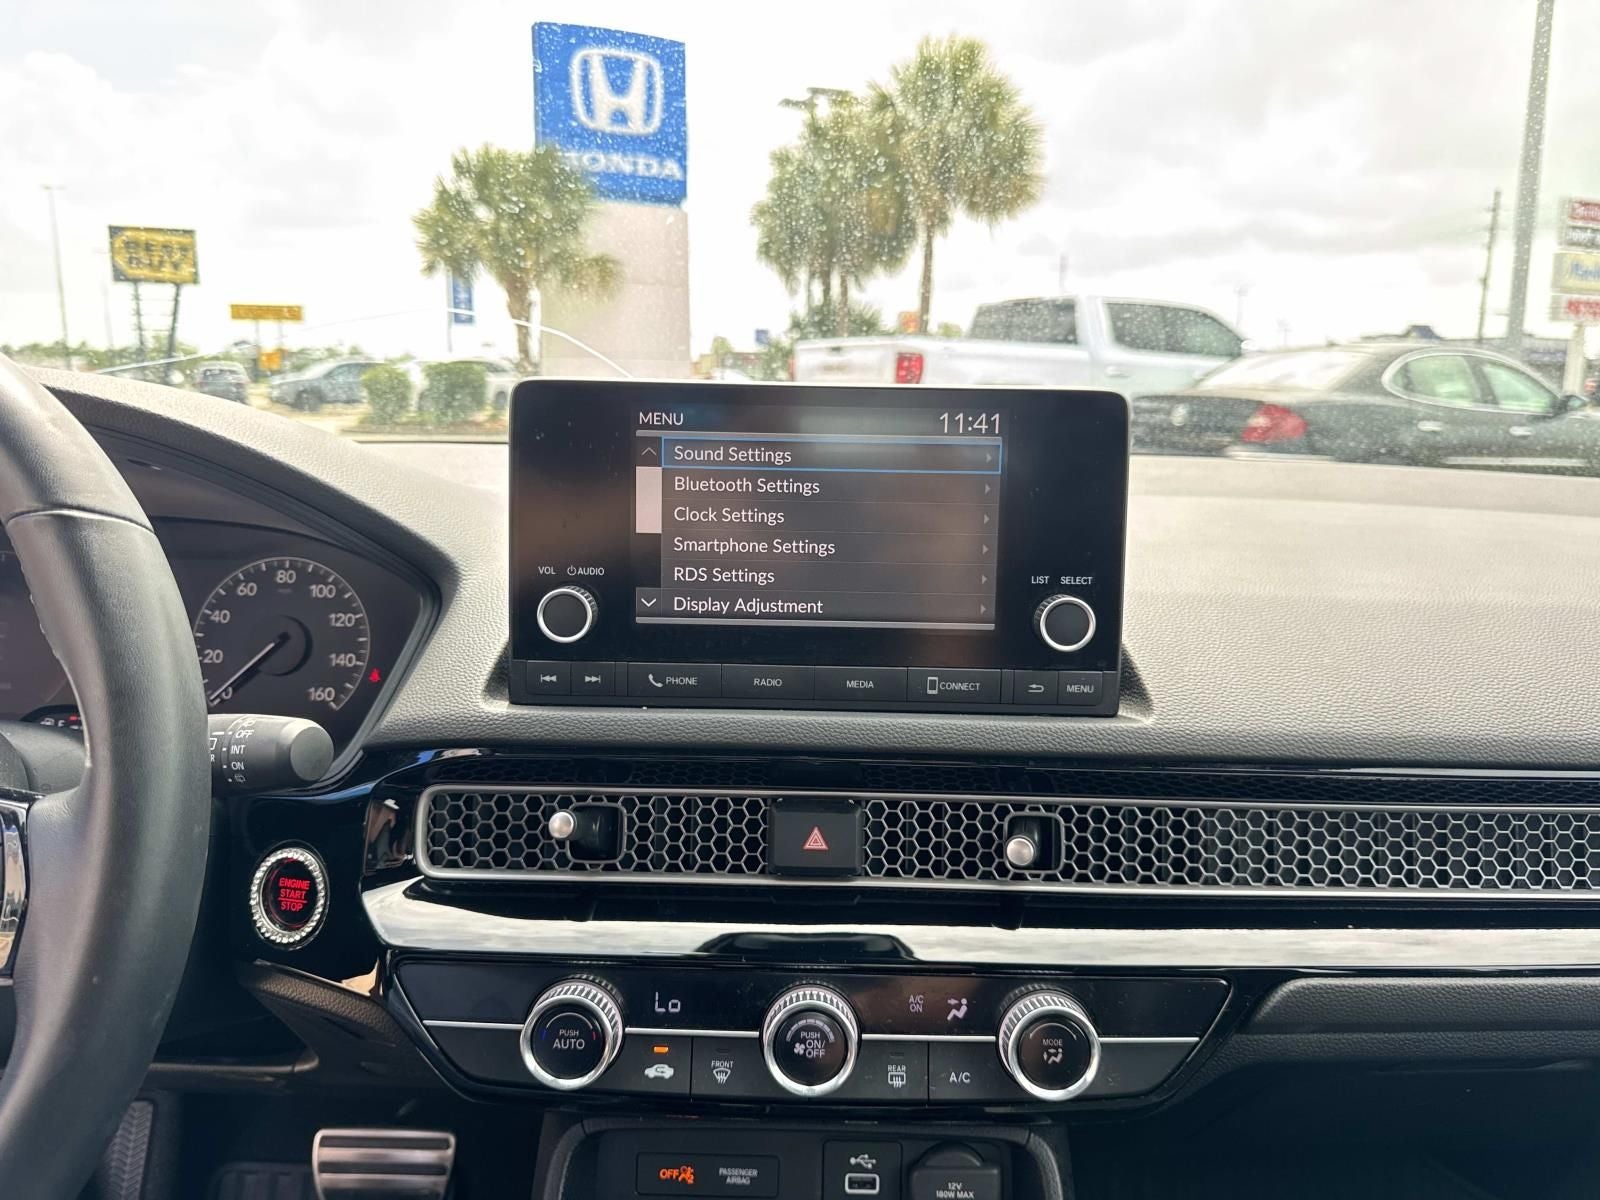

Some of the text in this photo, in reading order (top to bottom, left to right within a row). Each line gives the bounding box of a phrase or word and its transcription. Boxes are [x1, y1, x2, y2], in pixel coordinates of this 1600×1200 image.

[639, 412, 684, 425] MENU
[939, 411, 1001, 434] 11:41
[674, 446, 792, 465] Sound Settings
[674, 476, 820, 496] Bluetooth Settings
[674, 507, 785, 525] Clock Settings
[674, 537, 836, 556] Smartphone Settings
[538, 566, 605, 576] VOL AUDIO
[276, 570, 297, 584] 80
[674, 567, 775, 586] RDS Settings
[1031, 575, 1093, 585] LIST SELECT
[236, 583, 257, 596] 60
[309, 584, 336, 598] 100
[674, 597, 824, 616] Display Adjustment
[210, 610, 230, 623] 40
[329, 613, 355, 627] 120
[203, 650, 223, 663] 20
[329, 653, 356, 667] 140
[666, 676, 698, 686] PHONE
[754, 678, 782, 687] RADIO
[846, 680, 874, 689] MEDIA
[940, 681, 981, 691] CONNECT
[1066, 684, 1094, 693] MENU
[308, 687, 336, 701] 160
[236, 730, 254, 738] OFF
[230, 745, 246, 754] INT
[231, 762, 245, 770] ON
[279, 878, 310, 889] ENGINE
[280, 889, 306, 899] START
[281, 901, 303, 912] STOP
[654, 991, 681, 1013] Lo
[908, 994, 924, 1004] A/C
[909, 1004, 923, 1013] ON
[559, 1029, 579, 1037] PUSH
[800, 1031, 821, 1039] PUSH
[553, 1038, 585, 1050] AUTO
[1042, 1038, 1063, 1046] MODE
[805, 1049, 826, 1059] OFF
[711, 1060, 734, 1069] FRONT
[888, 1064, 906, 1072] REAR
[949, 1072, 971, 1083] A/C
[659, 1168, 679, 1180] OFF
[718, 1167, 759, 1177] PASSENGER
[726, 1176, 751, 1185] AIRBAG
[948, 1181, 963, 1190] 12V
[957, 1191, 974, 1199] MAX
